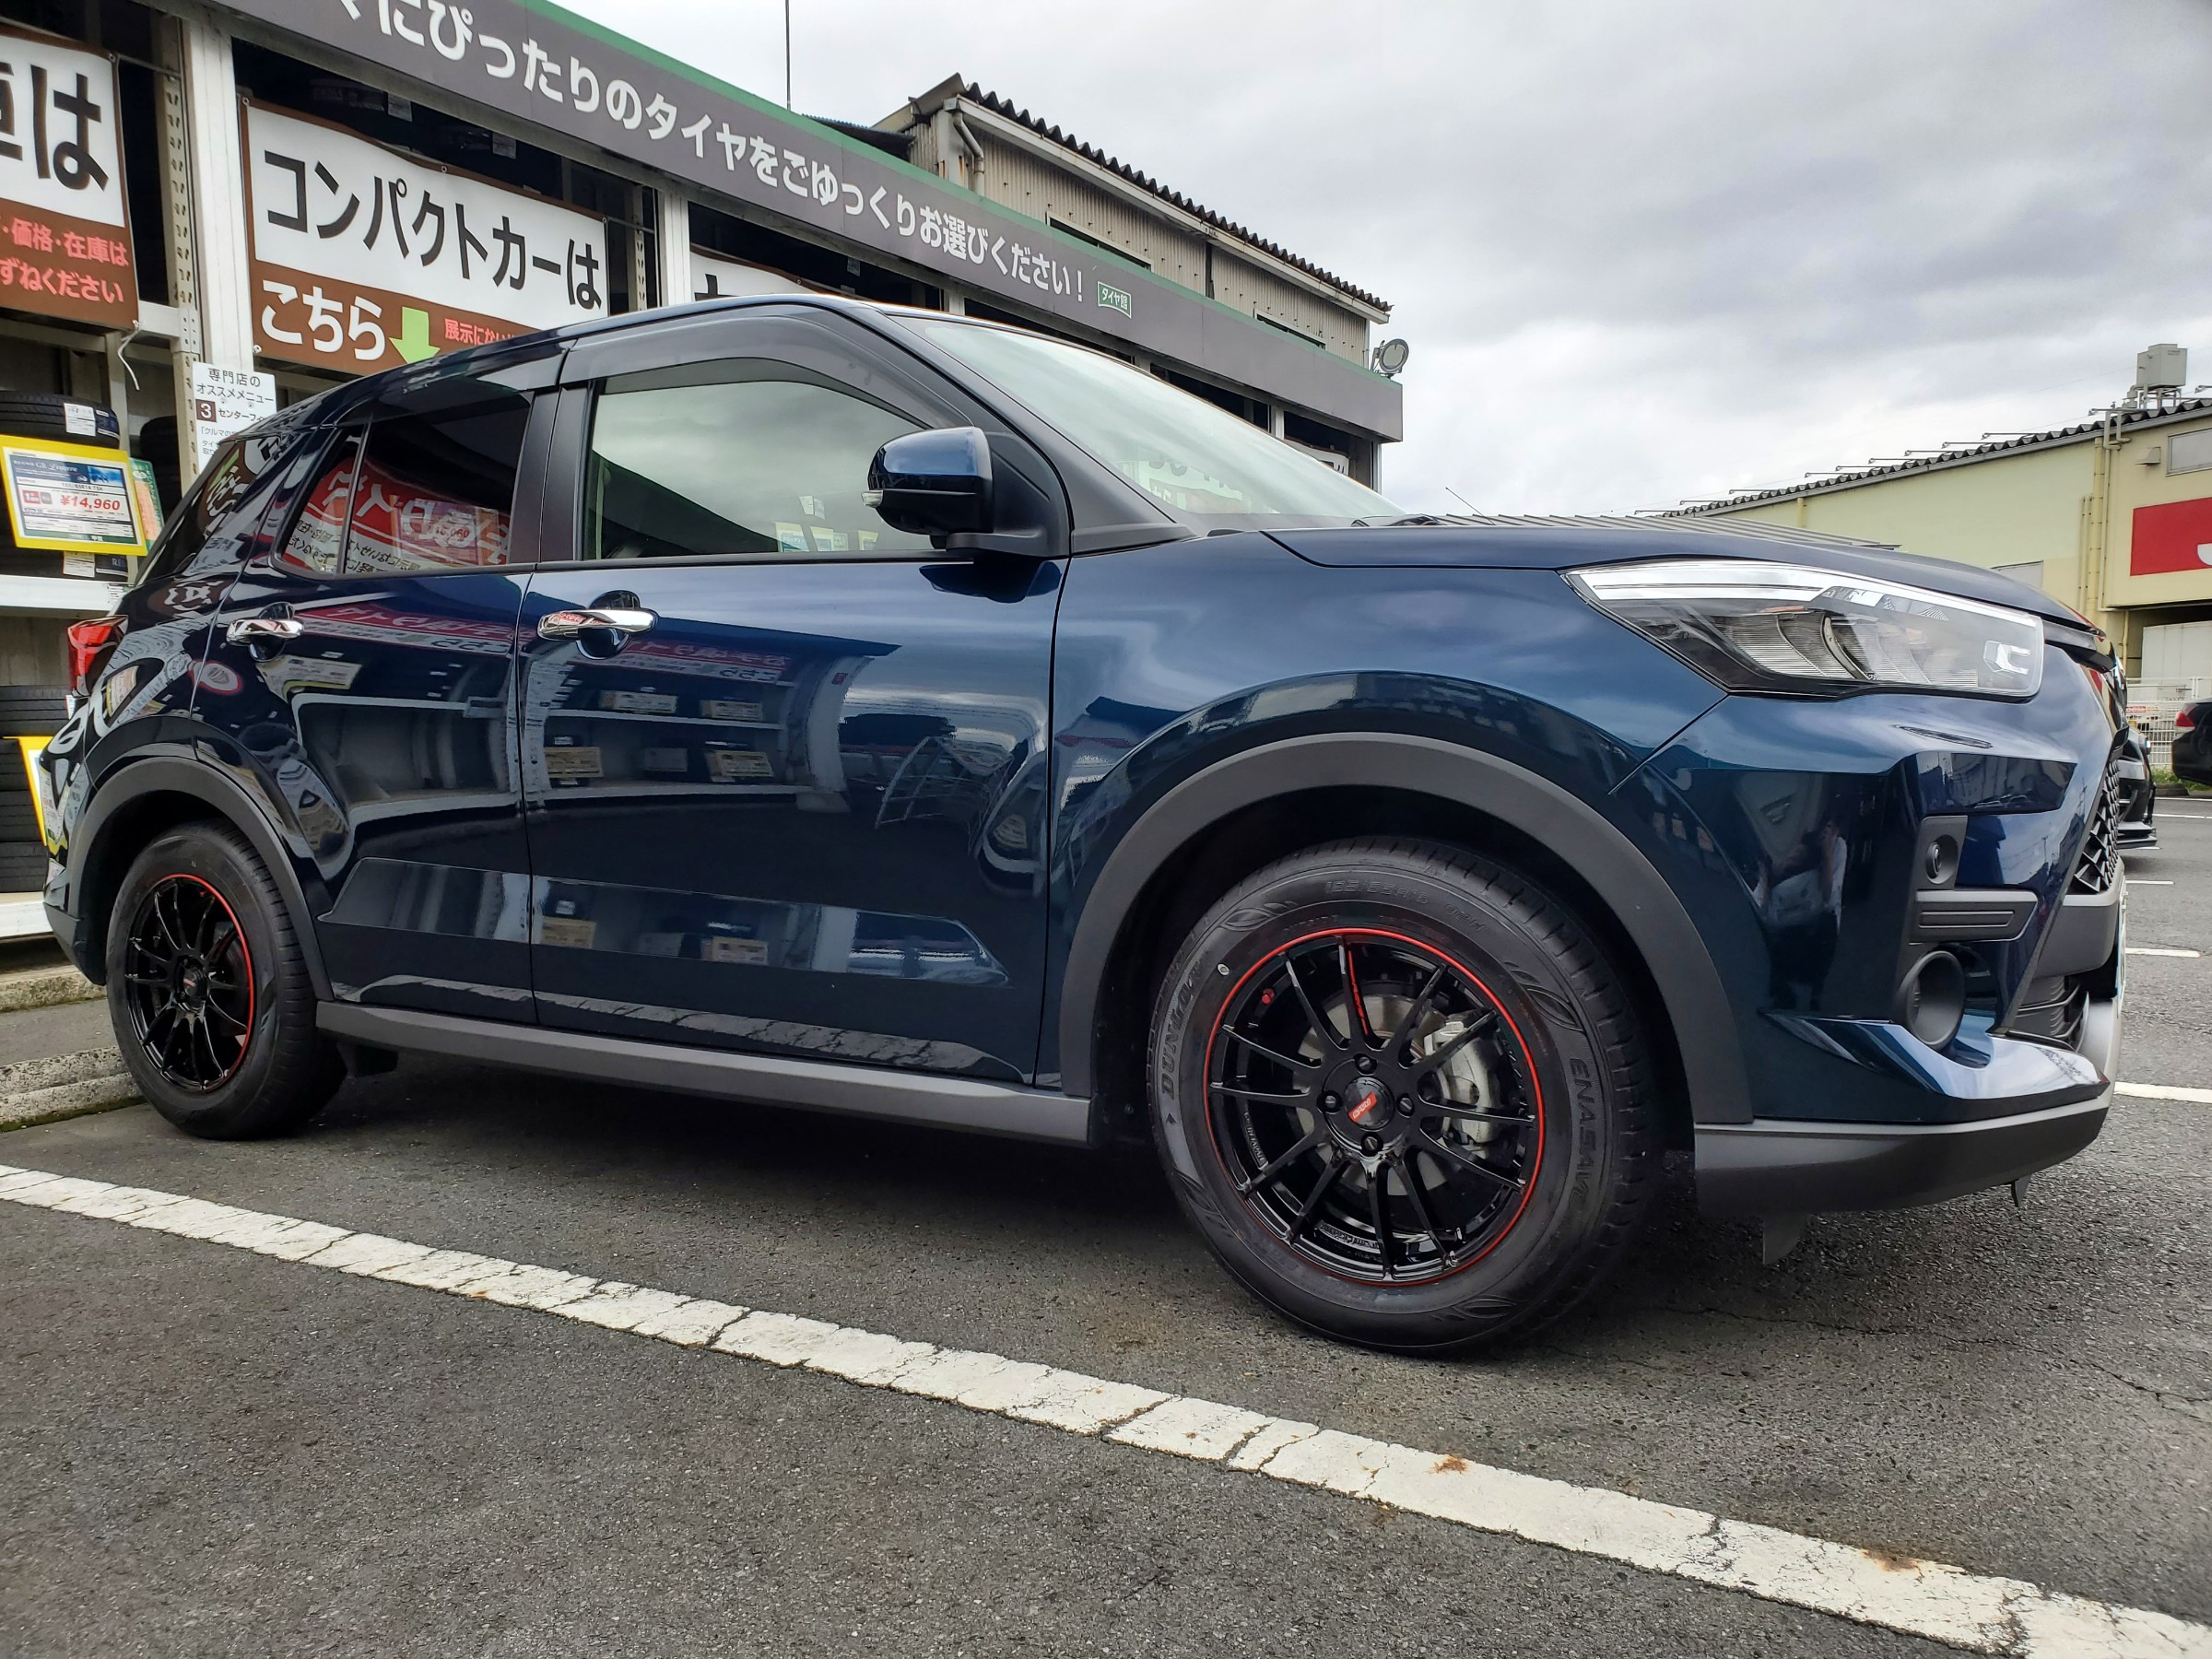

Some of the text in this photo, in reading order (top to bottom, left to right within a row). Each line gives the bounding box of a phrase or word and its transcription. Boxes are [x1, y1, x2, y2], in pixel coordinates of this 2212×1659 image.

[264, 149, 603, 310] コンパクトカーは
[1101, 288, 1128, 311] タイヤ館
[261, 280, 386, 361] こちら
[207, 368, 261, 388] 専門店の
[196, 383, 275, 404] オススメメニュー
[200, 403, 265, 422] 3 センターフ
[60, 494, 121, 511] ¥14,960
